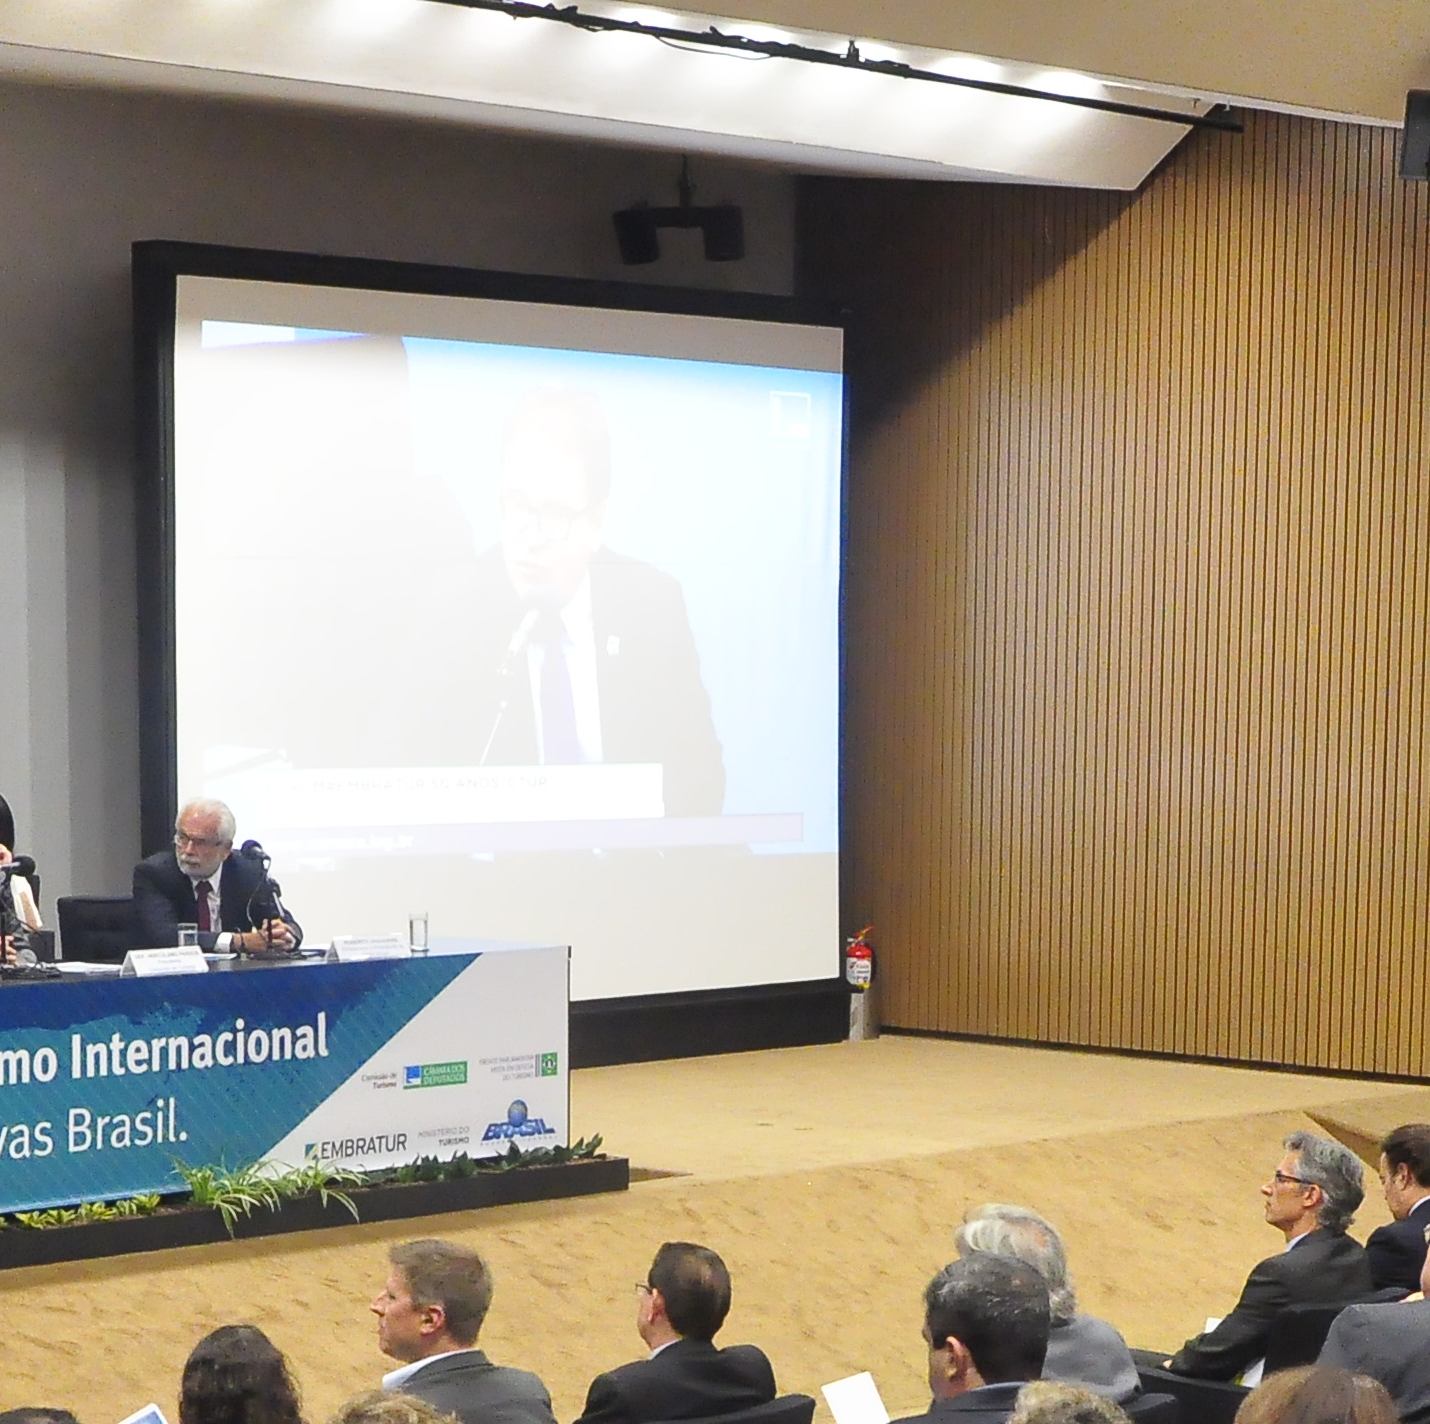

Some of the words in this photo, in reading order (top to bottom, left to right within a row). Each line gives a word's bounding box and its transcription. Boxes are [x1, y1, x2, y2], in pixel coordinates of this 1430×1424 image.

[71, 1011, 329, 1079] Internacional
[68, 1097, 189, 1153] Brasil.
[481, 1118, 556, 1142] BRASIL
[321, 1133, 408, 1160] EMBRATUR
[438, 1136, 469, 1146] TURISMO
